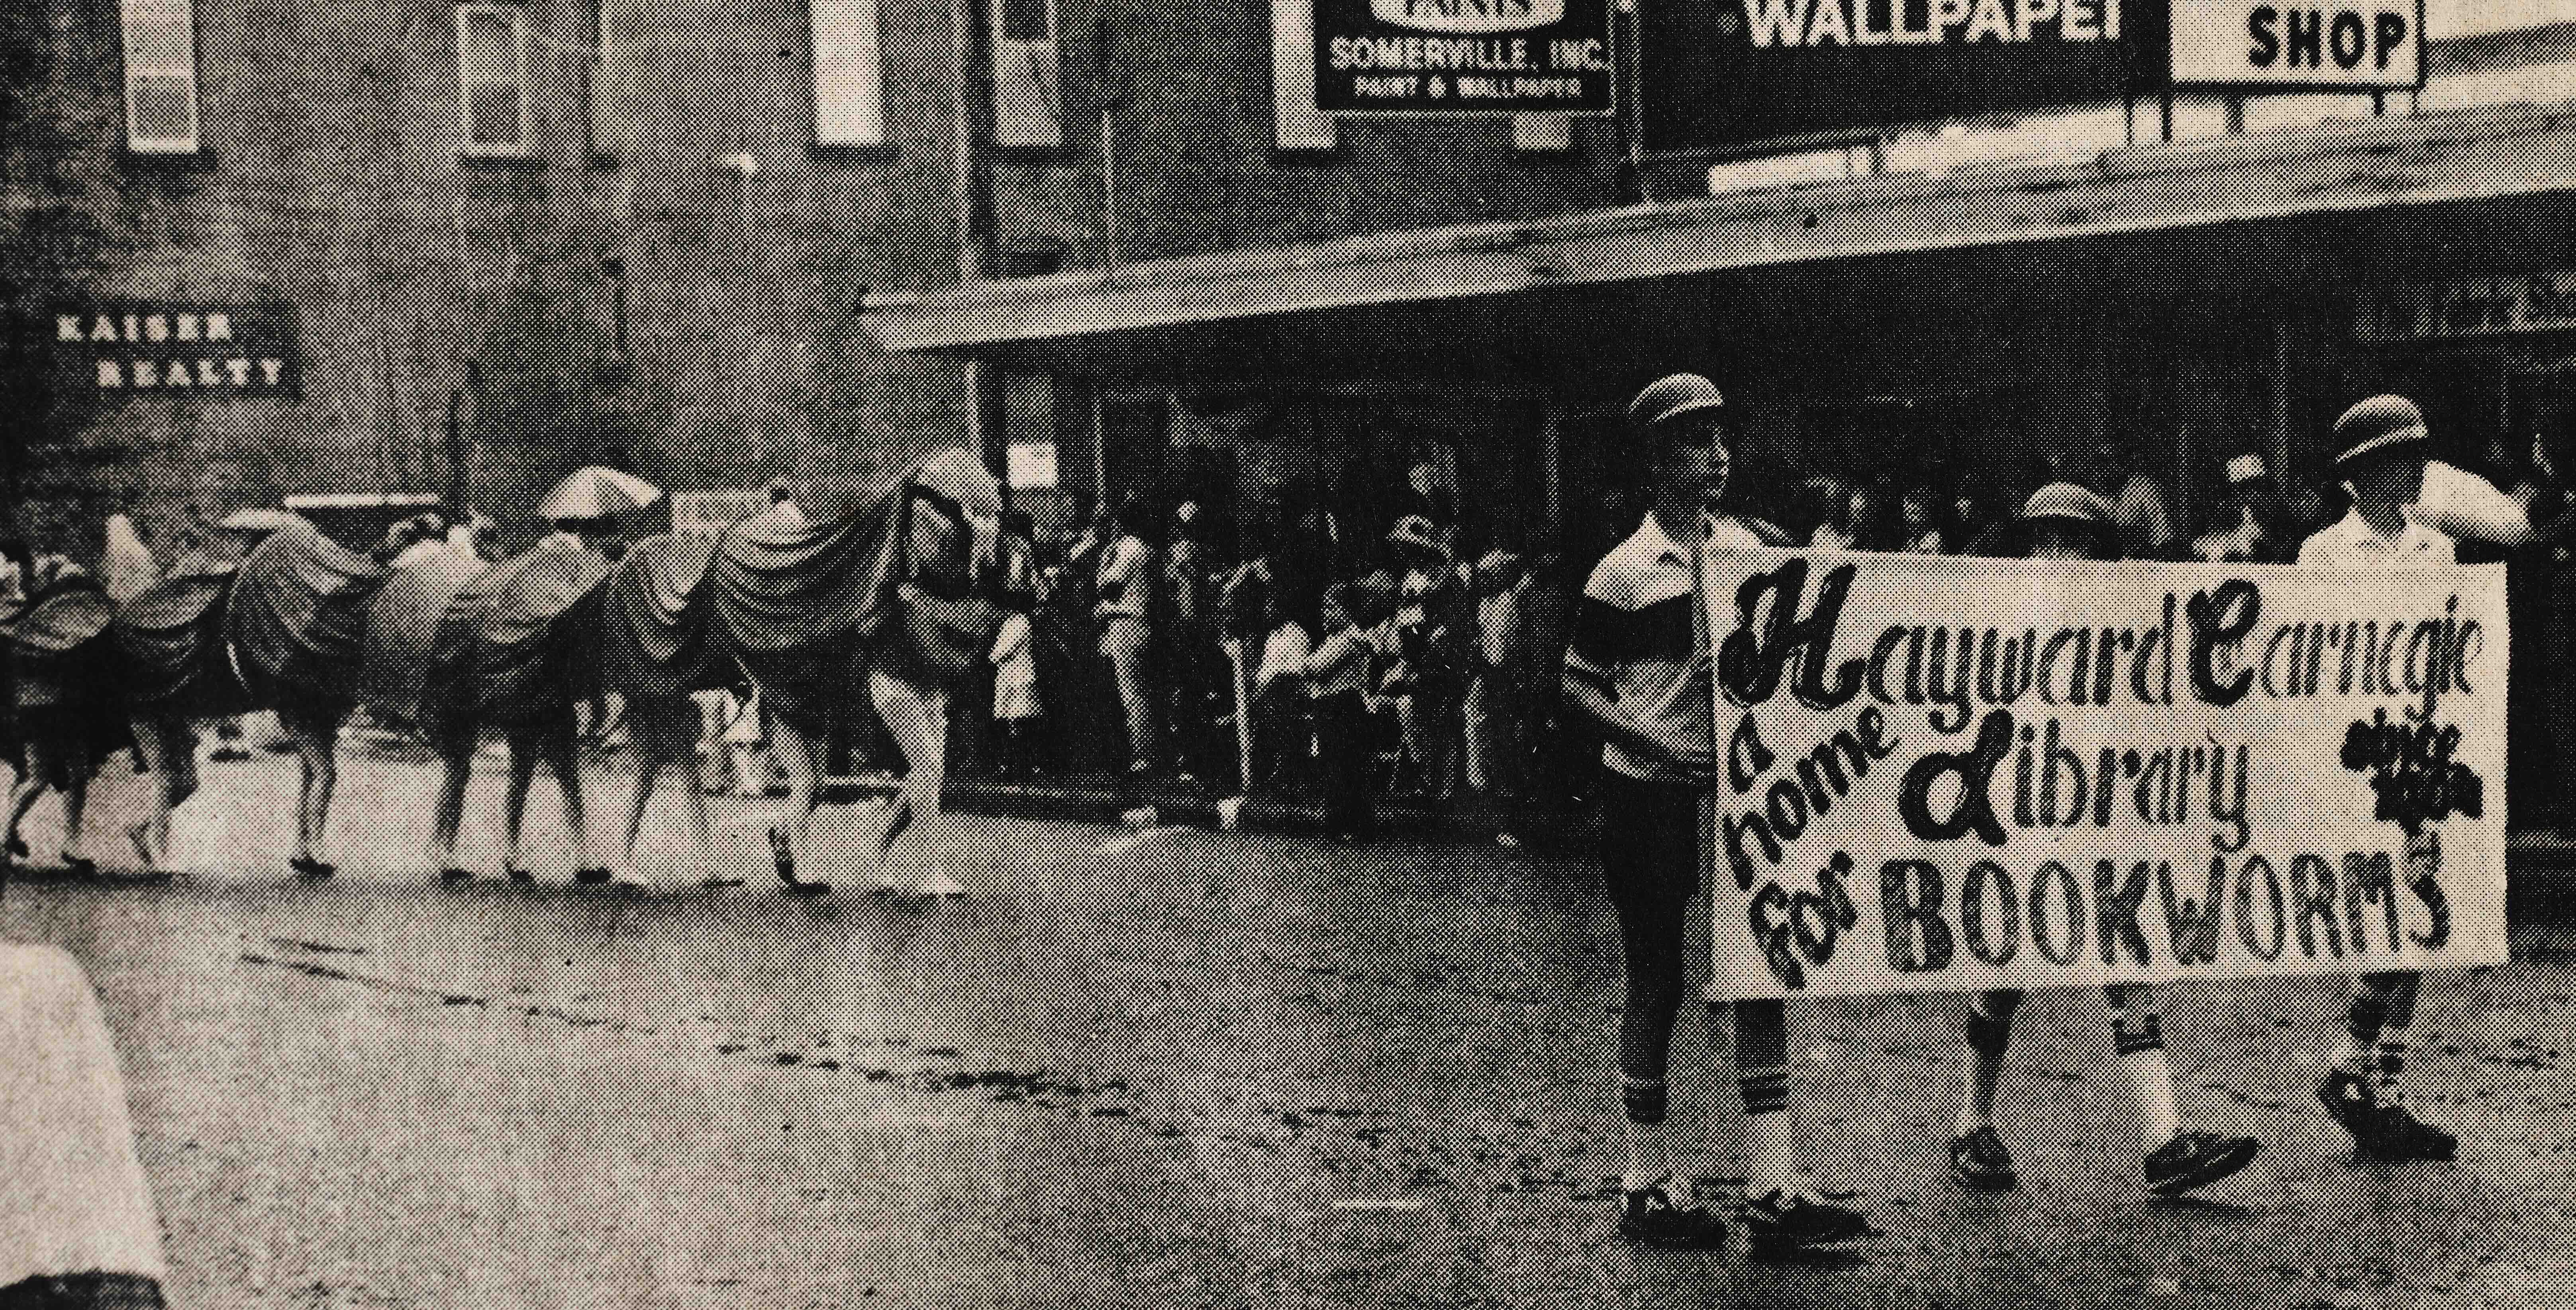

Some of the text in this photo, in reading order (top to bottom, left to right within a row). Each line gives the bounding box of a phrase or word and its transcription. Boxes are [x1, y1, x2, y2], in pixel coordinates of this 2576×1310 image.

[1329, 36, 1539, 72] SOMERVILLE,
[2247, 5, 2406, 70] SHOP
[1355, 76, 1582, 99] PAINT & WALLPAPER
[58, 313, 232, 342] KAISER
[98, 358, 282, 387] REALTY
[1718, 558, 2481, 734] Hayward Carnegie
[1728, 713, 1775, 794] a
[1897, 708, 2250, 853] Library
[1723, 705, 1900, 892] home
[1748, 850, 1857, 990] for
[1879, 833, 2451, 973] BOOKWORMS
